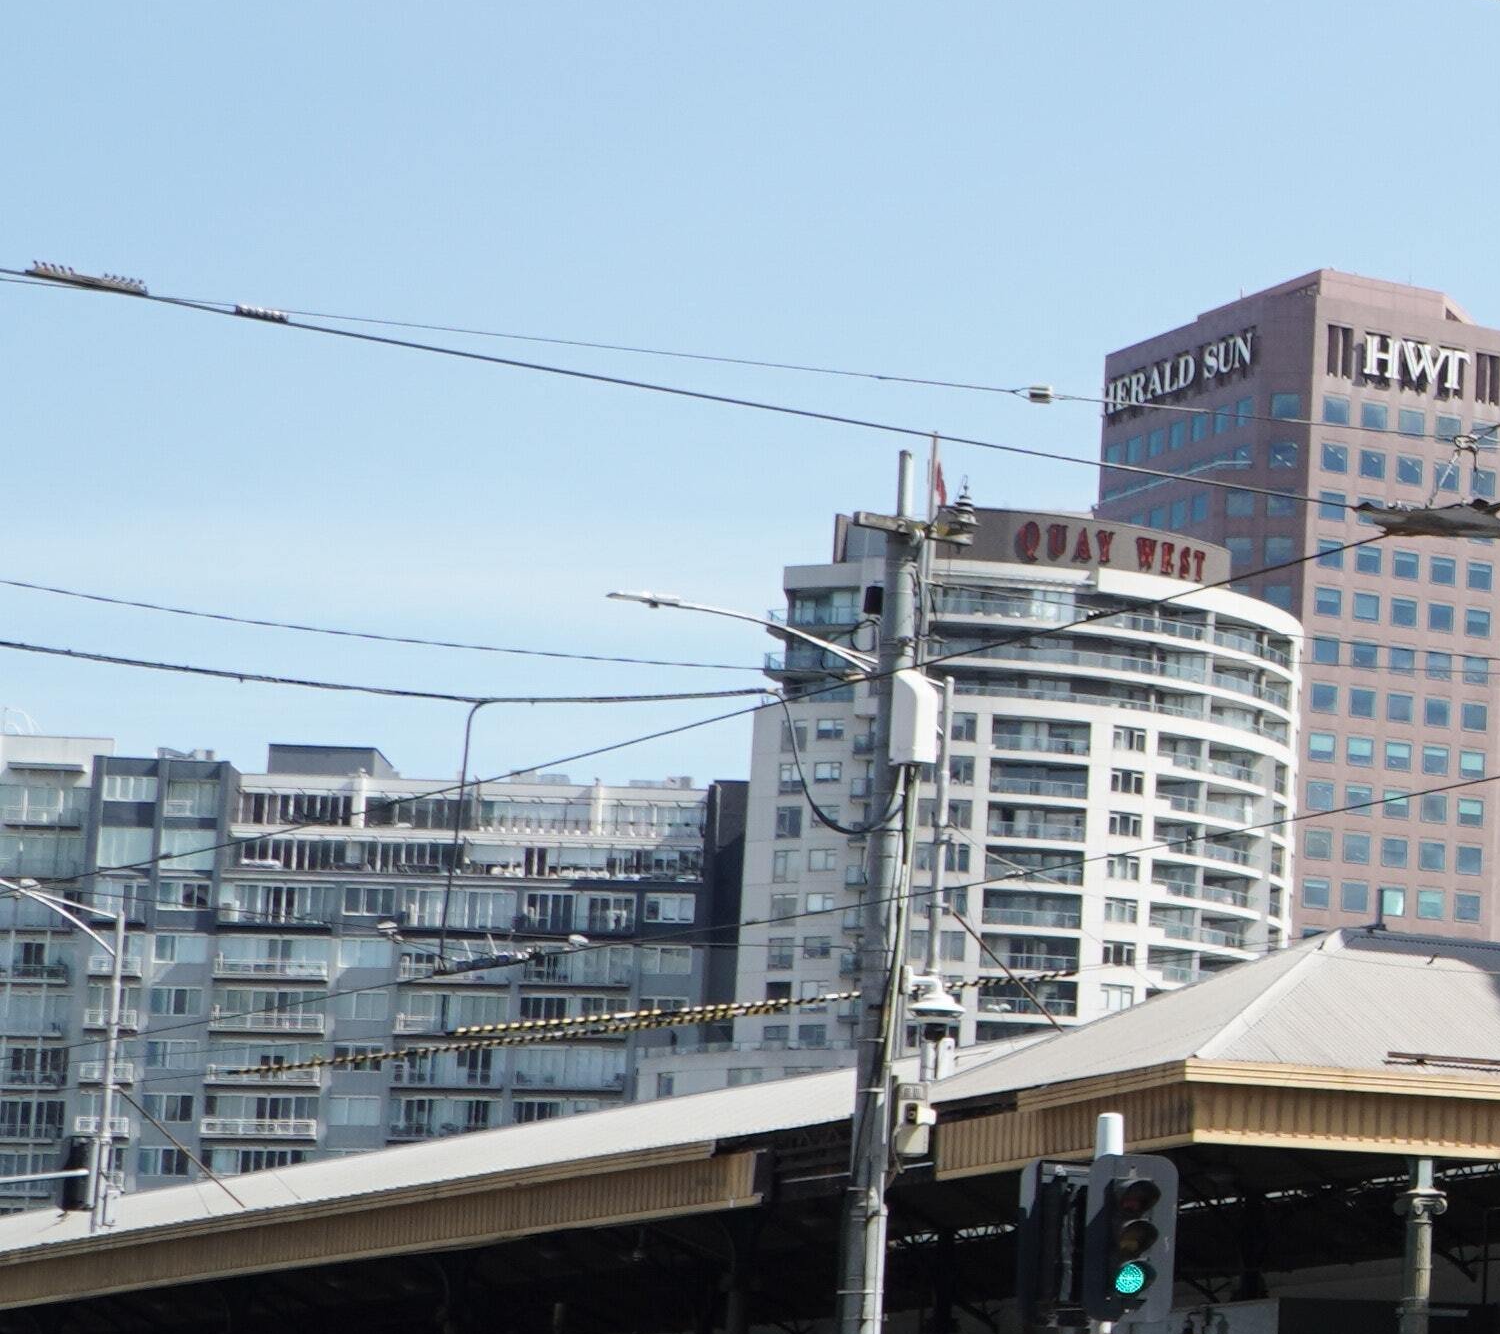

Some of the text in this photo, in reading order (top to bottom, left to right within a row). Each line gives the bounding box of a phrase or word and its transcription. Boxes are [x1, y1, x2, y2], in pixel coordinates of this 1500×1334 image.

[1104, 333, 1253, 415] HERALD SUN
[1363, 334, 1471, 390] HWT
[1015, 521, 1207, 582] QUAY WEST
